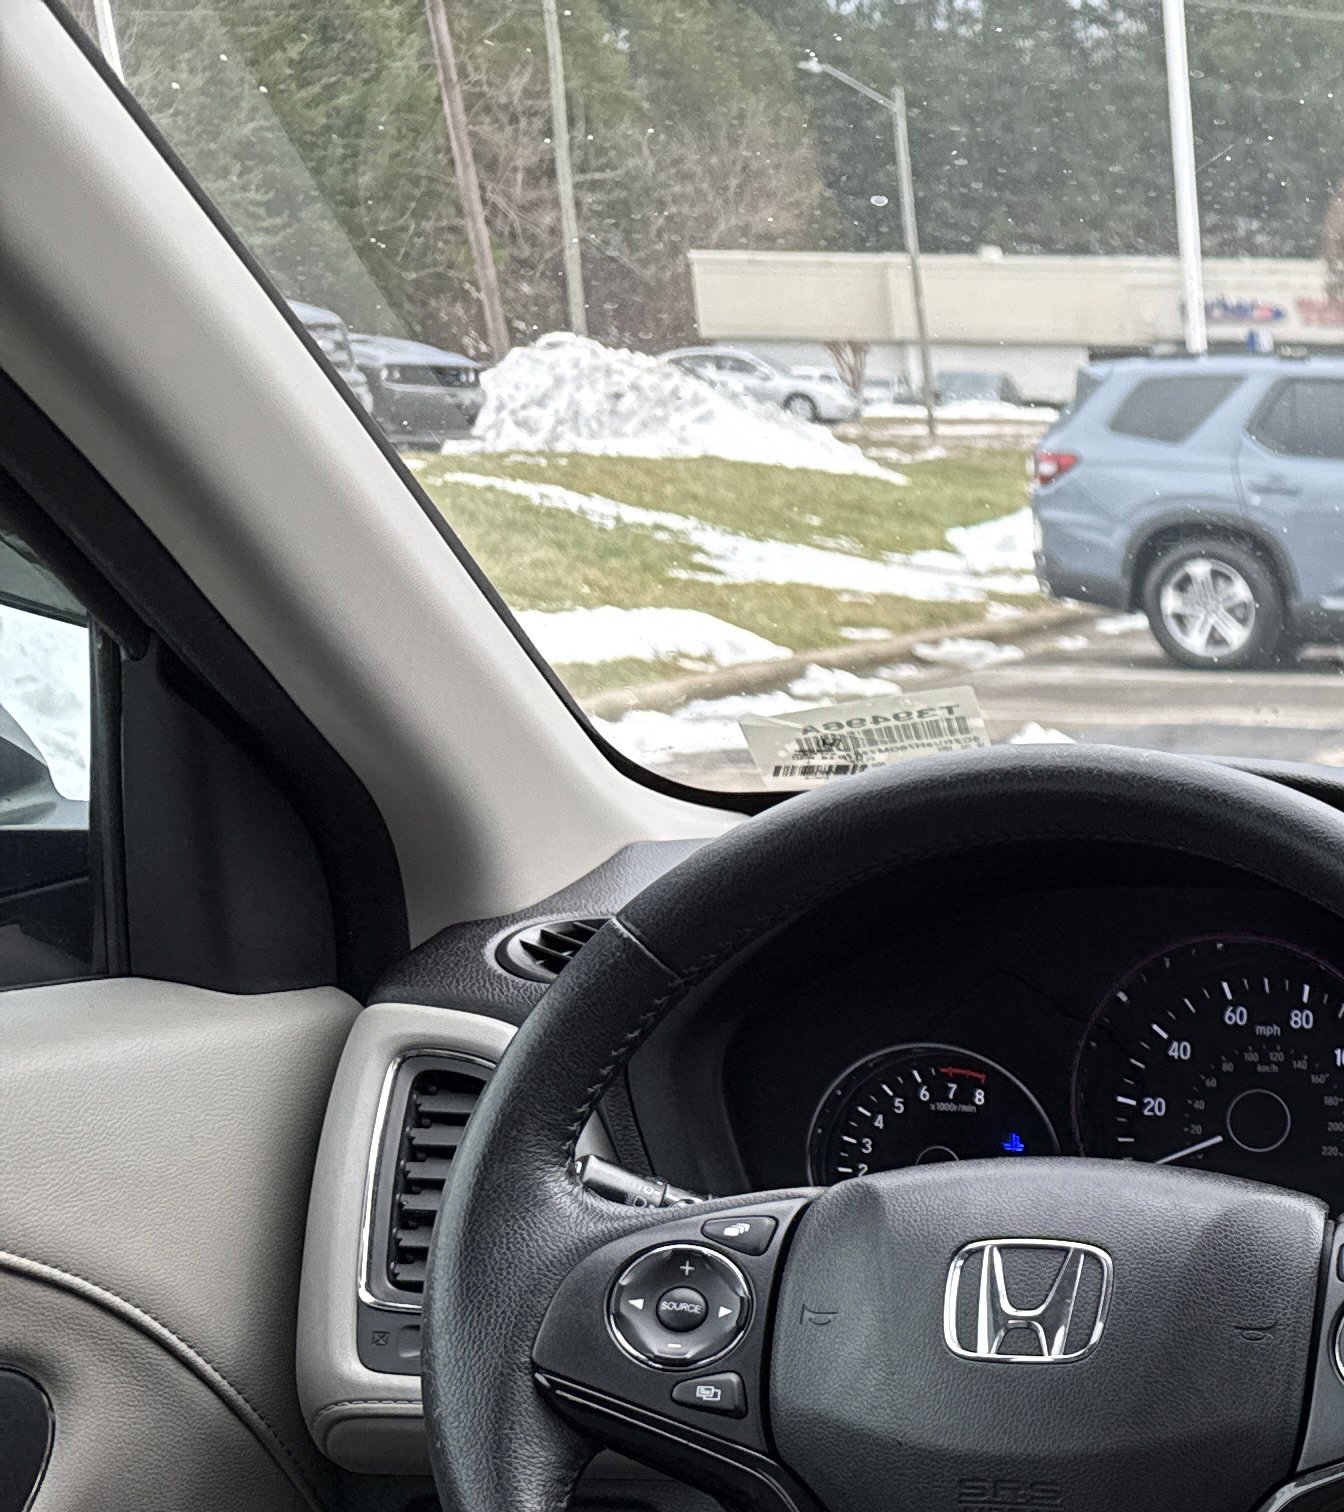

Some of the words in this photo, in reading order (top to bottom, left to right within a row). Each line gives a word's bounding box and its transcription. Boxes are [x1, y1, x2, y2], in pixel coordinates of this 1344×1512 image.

[1224, 1006, 1247, 1026] 60
[1290, 1010, 1314, 1029] 80
[1255, 1025, 1281, 1038] mph
[1168, 1041, 1191, 1060] 40
[919, 1085, 930, 1101] 6
[948, 1083, 958, 1099] 7
[974, 1089, 985, 1106] 8
[894, 1098, 904, 1114] 5
[1143, 1098, 1166, 1116] 20
[873, 1114, 884, 1130] 4
[862, 1138, 873, 1154] 3
[858, 1164, 868, 1177] 2
[661, 1301, 702, 1314] SOURCE
